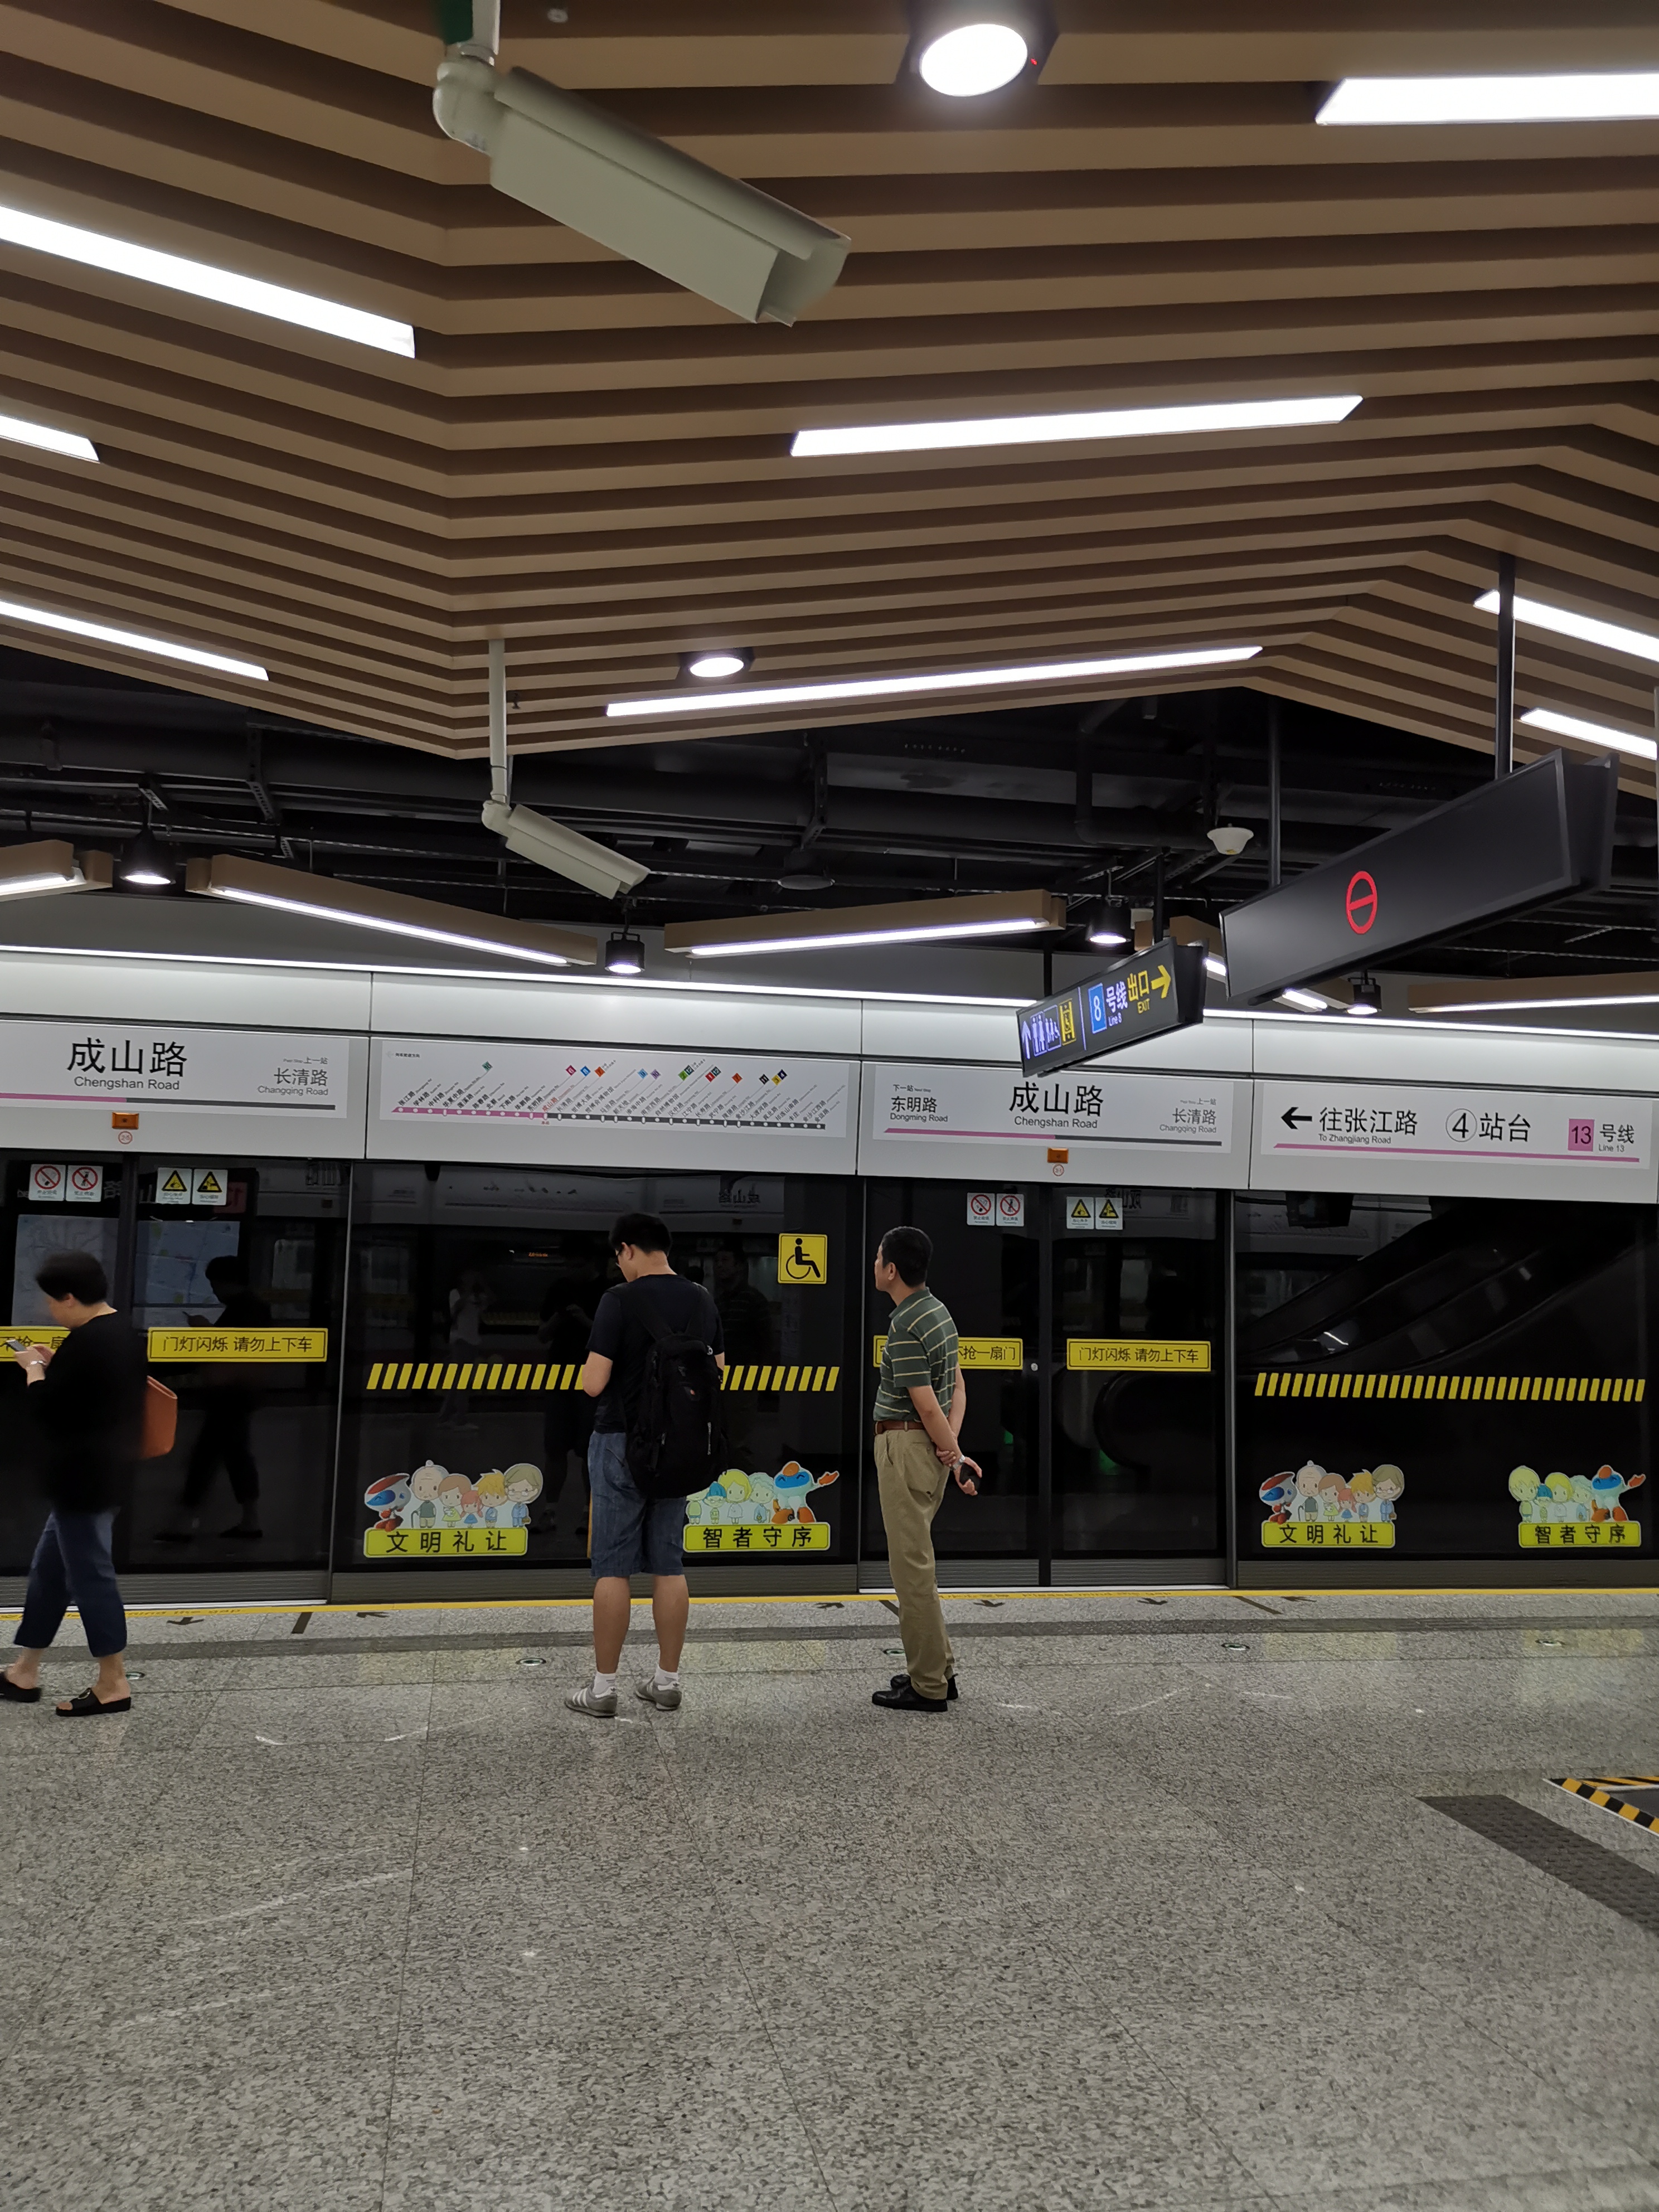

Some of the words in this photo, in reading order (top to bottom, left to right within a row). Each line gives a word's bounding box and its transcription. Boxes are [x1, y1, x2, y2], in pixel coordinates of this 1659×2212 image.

[1094, 995, 1102, 1022] 8
[1106, 981, 1128, 1013] 号线
[1127, 970, 1149, 1002] 出口
[1137, 998, 1151, 1014] EXIT
[1108, 1016, 1118, 1027] Line
[66, 1036, 188, 1078] 成山路
[74, 1076, 144, 1090] Chengshan
[148, 1078, 180, 1090] Road
[274, 1067, 328, 1086] 长清路
[257, 1085, 304, 1097] Changqing
[306, 1087, 328, 1096] Road
[893, 1084, 914, 1092] 下一站
[891, 1095, 937, 1113] 东明路
[1009, 1080, 1104, 1117] 成山路
[890, 1112, 926, 1123] Dongming
[1014, 1115, 1069, 1129] Chengshan
[1072, 1117, 1098, 1128] Road
[1172, 1107, 1216, 1125] 长清路
[1318, 1106, 1418, 1136] 往张江路
[1570, 1124, 1592, 1144] 13
[1599, 1123, 1635, 1144] 号线
[1160, 1124, 1196, 1134] Changqing
[1318, 1133, 1327, 1142] To
[1328, 1134, 1370, 1144] Zhangjiang
[1372, 1136, 1391, 1144] Road
[1598, 1143, 1613, 1153] Line
[1616, 1144, 1625, 1153] 13
[162, 1336, 229, 1352] 门灯闪烁
[233, 1336, 312, 1353] 请勿上下车
[1078, 1346, 1132, 1362] 门灯闪烁
[1135, 1347, 1199, 1364] 请勿上下车
[386, 1530, 508, 1553] 文明礼让
[702, 1527, 813, 1549] 智者守序
[1279, 1524, 1379, 1545] 文明礼让
[1534, 1524, 1627, 1545] 智者守序
